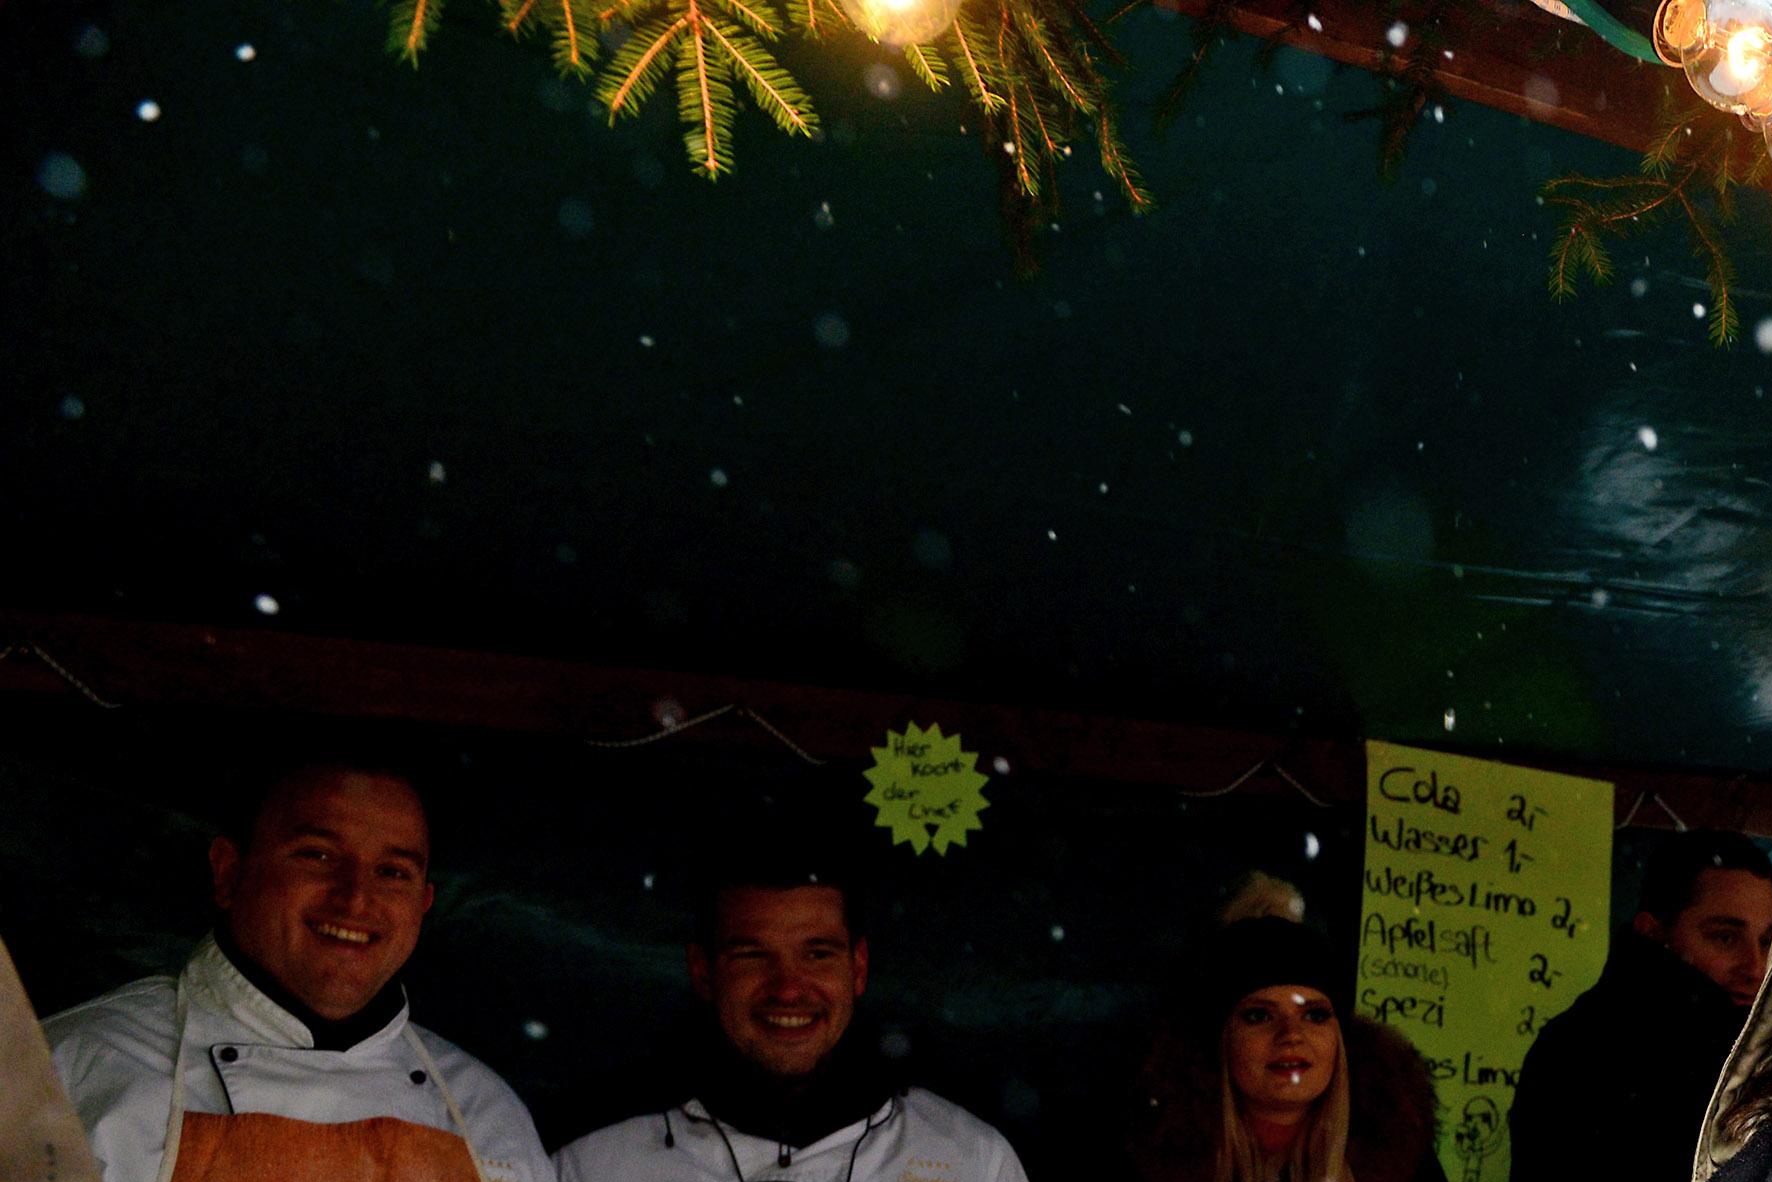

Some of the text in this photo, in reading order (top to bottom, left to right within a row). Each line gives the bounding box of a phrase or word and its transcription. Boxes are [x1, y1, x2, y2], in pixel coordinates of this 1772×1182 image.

[1379, 766, 1461, 816] Cola
[1370, 814, 1489, 862] Wasser
[1361, 988, 1446, 1029] Spezi
